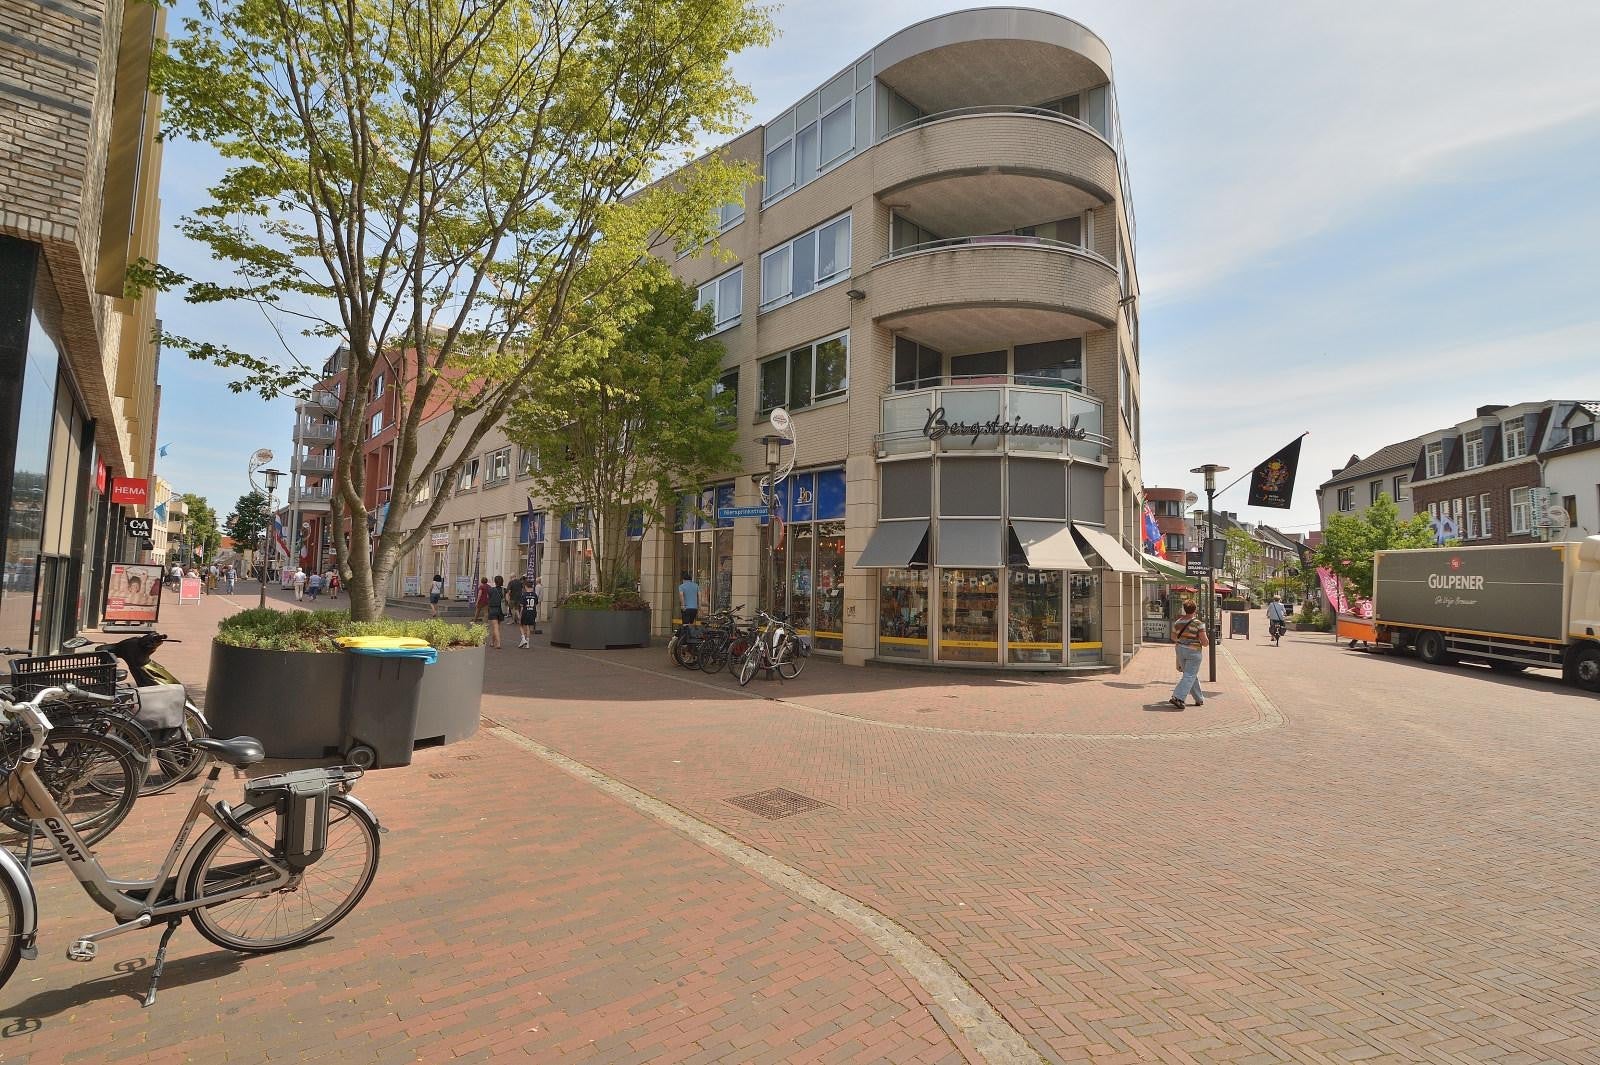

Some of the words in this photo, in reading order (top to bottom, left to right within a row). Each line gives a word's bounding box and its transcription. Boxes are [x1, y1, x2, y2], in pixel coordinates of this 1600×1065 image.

[115, 486, 146, 496] HEMA
[1428, 574, 1484, 590] GULPENER
[526, 598, 535, 607] 10
[45, 817, 86, 863] GIANT
